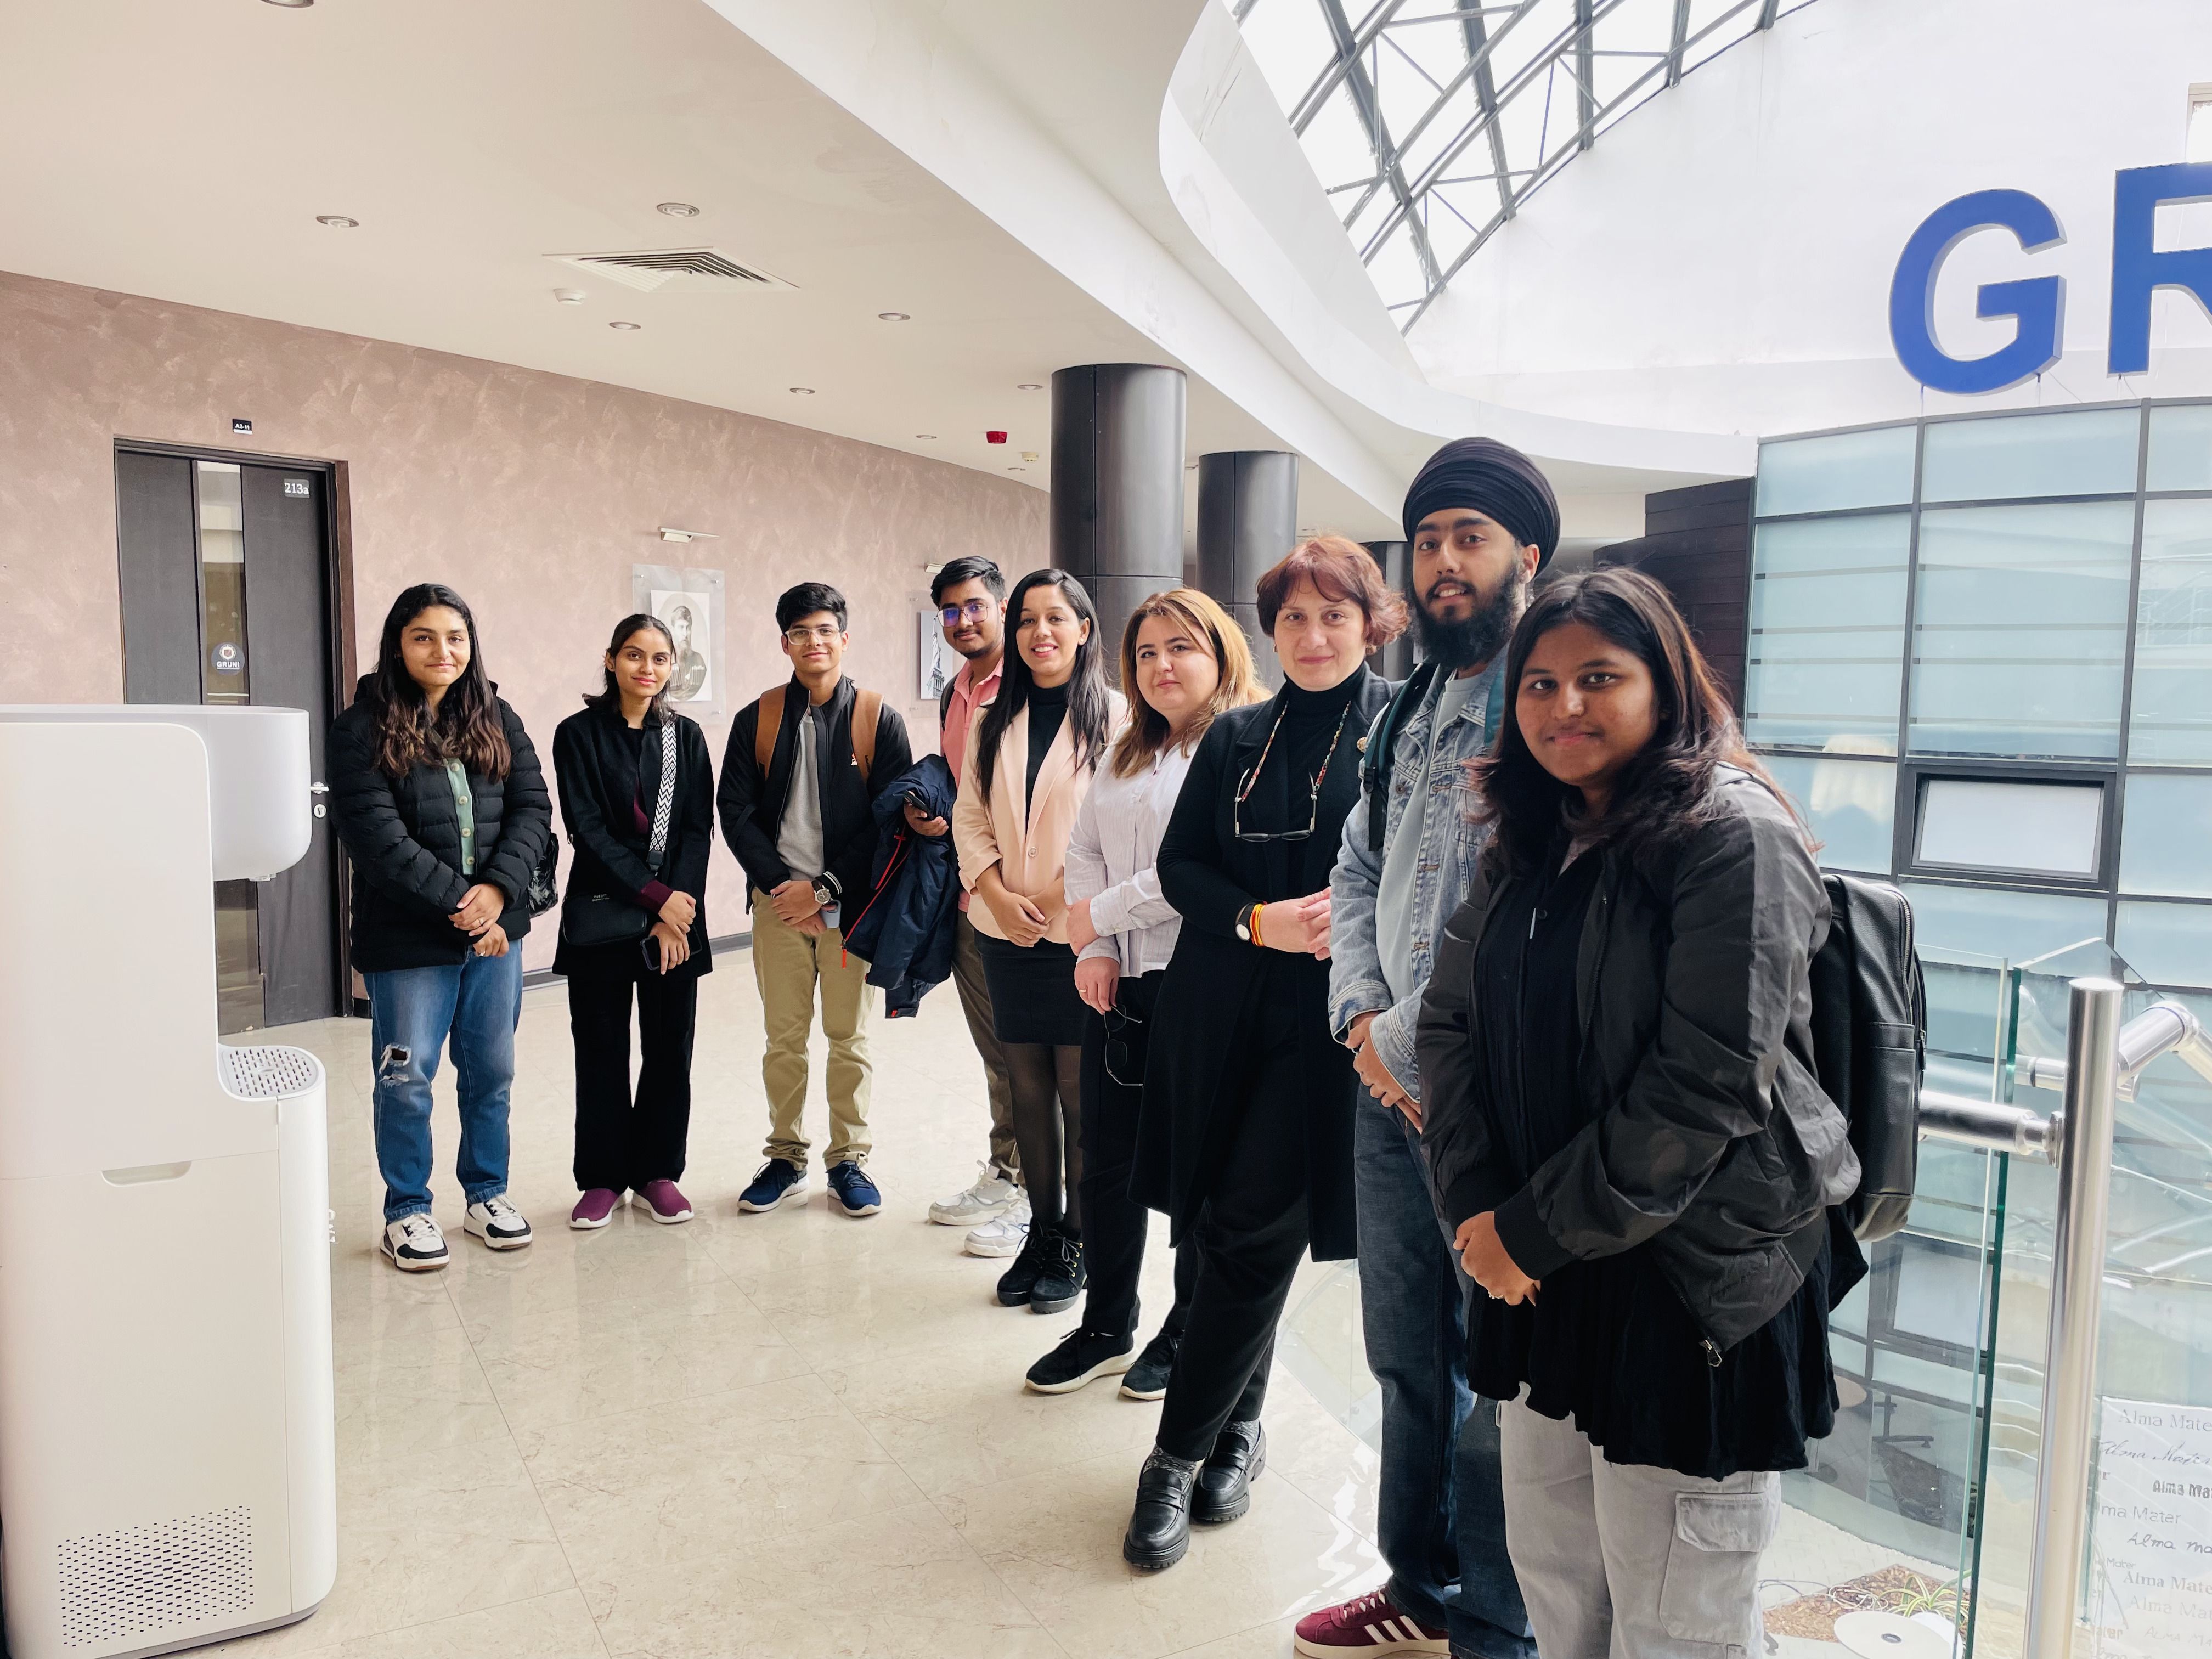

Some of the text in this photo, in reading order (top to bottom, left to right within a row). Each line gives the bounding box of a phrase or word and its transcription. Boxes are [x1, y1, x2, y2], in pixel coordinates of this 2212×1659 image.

[1887, 160, 2212, 397] GR
[284, 482, 309, 495] 213a
[2118, 1409, 2163, 1427] Alma
[2153, 1480, 2212, 1499] Alma Ma
[2133, 1506, 2182, 1524] Mater
[2127, 1531, 2176, 1550] Alma
[2106, 1558, 2136, 1569] Mater
[2123, 1571, 2164, 1588] Alma
[2129, 1595, 2173, 1614] Alma
